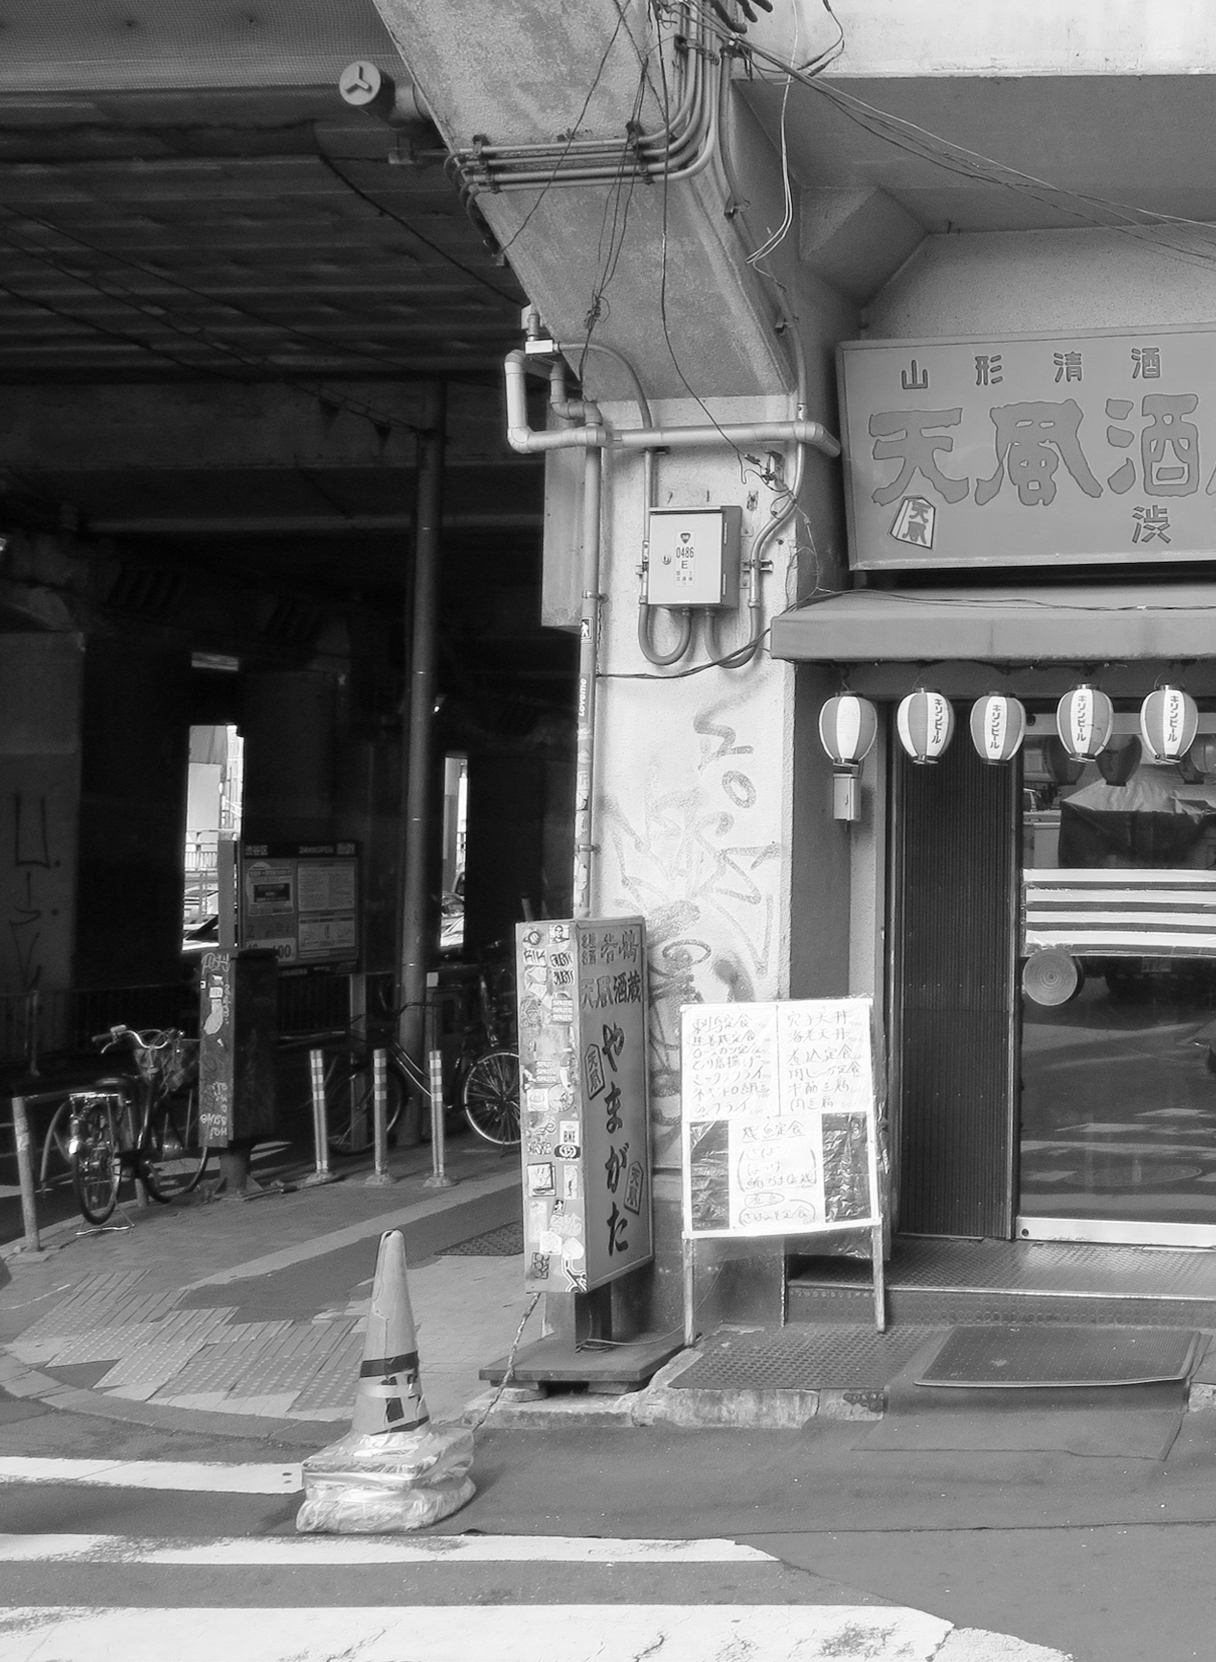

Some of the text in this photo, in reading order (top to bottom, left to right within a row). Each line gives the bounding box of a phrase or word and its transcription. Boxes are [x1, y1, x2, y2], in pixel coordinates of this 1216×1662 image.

[901, 347, 1161, 390] 山形清酒
[676, 546, 694, 559] 0486
[681, 560, 688, 569] E
[931, 698, 943, 745] キリンビール
[989, 704, 1001, 750] キリンビール
[1076, 695, 1087, 742] キリンビール
[1167, 695, 1180, 742] キリンビール
[602, 1022, 630, 1257] やまがた
